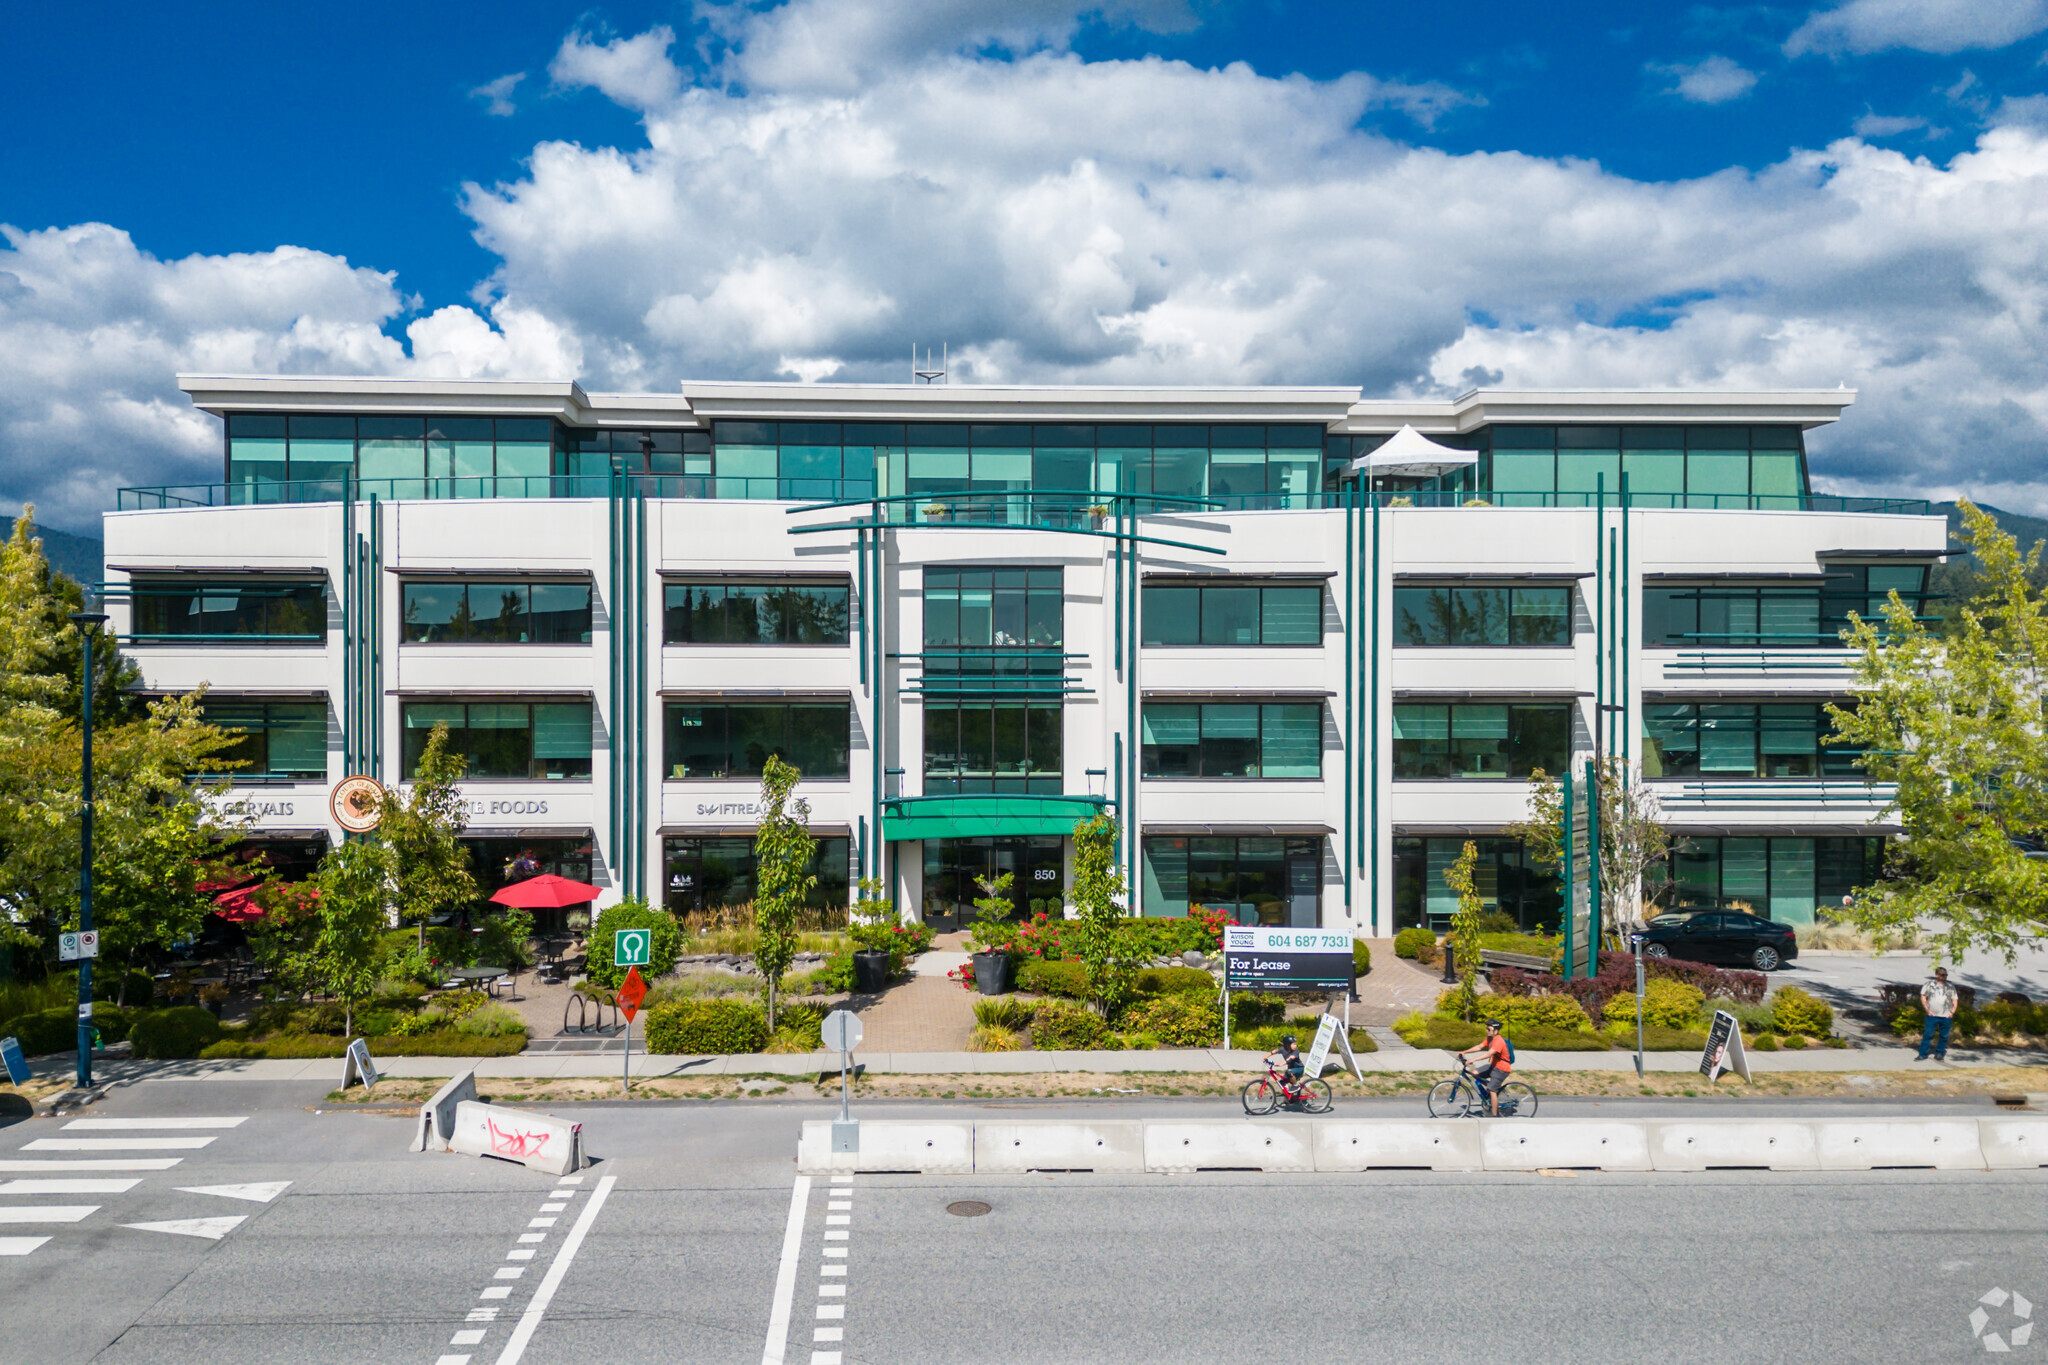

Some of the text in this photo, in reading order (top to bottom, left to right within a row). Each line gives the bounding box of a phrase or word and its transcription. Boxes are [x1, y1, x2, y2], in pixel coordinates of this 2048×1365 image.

[490, 801, 548, 814] FOODS
[697, 803, 812, 815] SWIFTREAL LD
[1034, 869, 1056, 880] 850
[1268, 935, 1349, 948] 604 687 7331
[1229, 958, 1291, 970] For Lease
